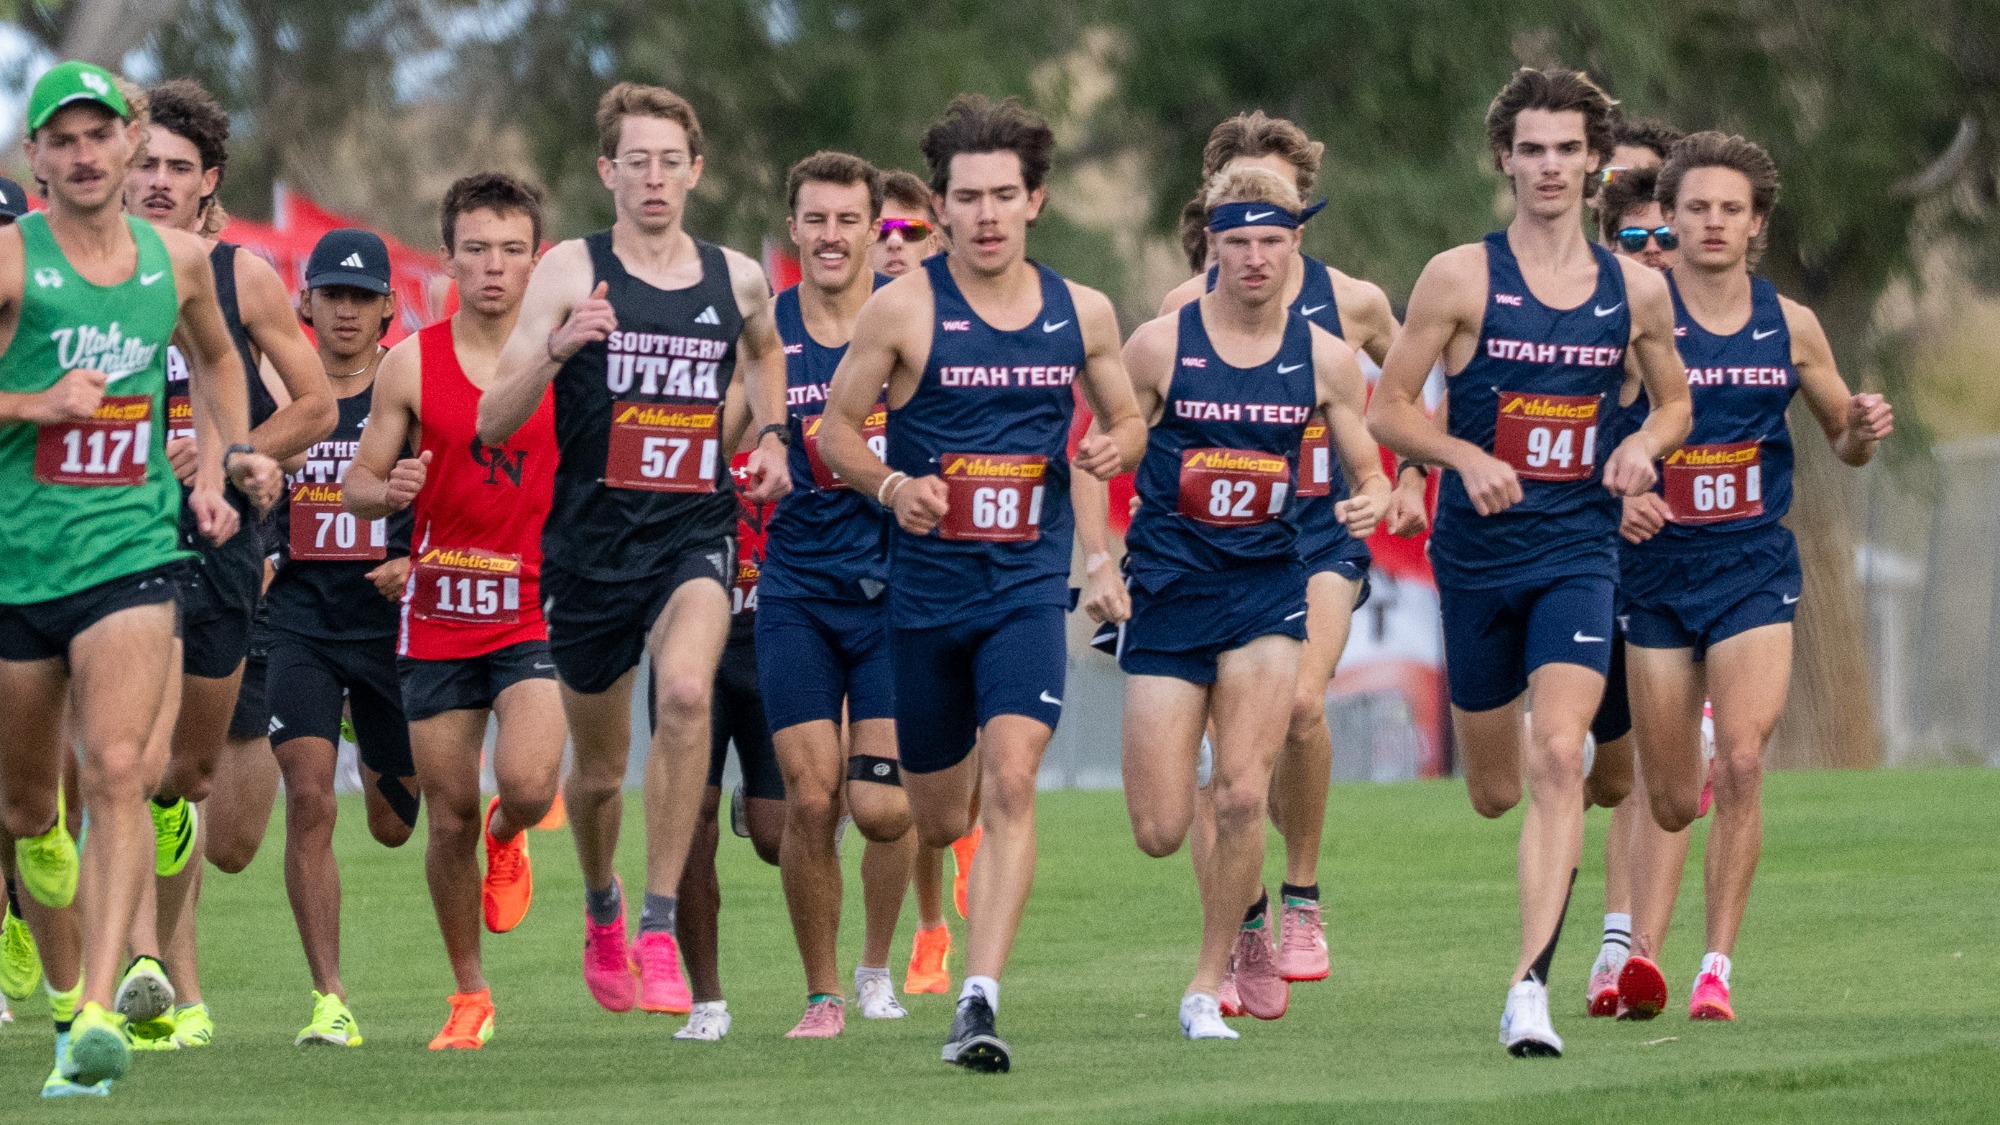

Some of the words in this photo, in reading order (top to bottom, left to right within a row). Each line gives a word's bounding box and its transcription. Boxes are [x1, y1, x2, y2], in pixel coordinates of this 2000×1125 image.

[1495, 294, 1523, 306] WAC
[942, 320, 970, 331] WAC
[50, 321, 122, 369] Utah
[607, 331, 728, 359] SOUTHERN
[1487, 339, 1556, 363] UTAH
[1560, 346, 1622, 367] TECH
[1181, 356, 1207, 368] WAC
[607, 353, 720, 399] UTAH
[940, 366, 1009, 386] UTAH
[1012, 366, 1076, 386] TECH
[1727, 368, 1787, 385] TECH
[615, 406, 691, 427] Athletic
[1175, 400, 1241, 421] UTAH
[1245, 404, 1310, 424] TECH
[1502, 397, 1577, 418] Athletic
[61, 430, 132, 474] 117
[641, 437, 690, 479] 57
[1526, 427, 1573, 468] 94
[1667, 449, 1736, 465] Athletic
[944, 458, 1021, 476] Athletic
[1184, 452, 1259, 469] Athletic
[292, 486, 342, 501] Athlet
[1209, 479, 1257, 517] 82
[1693, 473, 1735, 511] 66
[972, 486, 1020, 529] 68
[315, 513, 356, 548] 70
[419, 549, 490, 569] Athletic
[436, 576, 499, 615] 115
